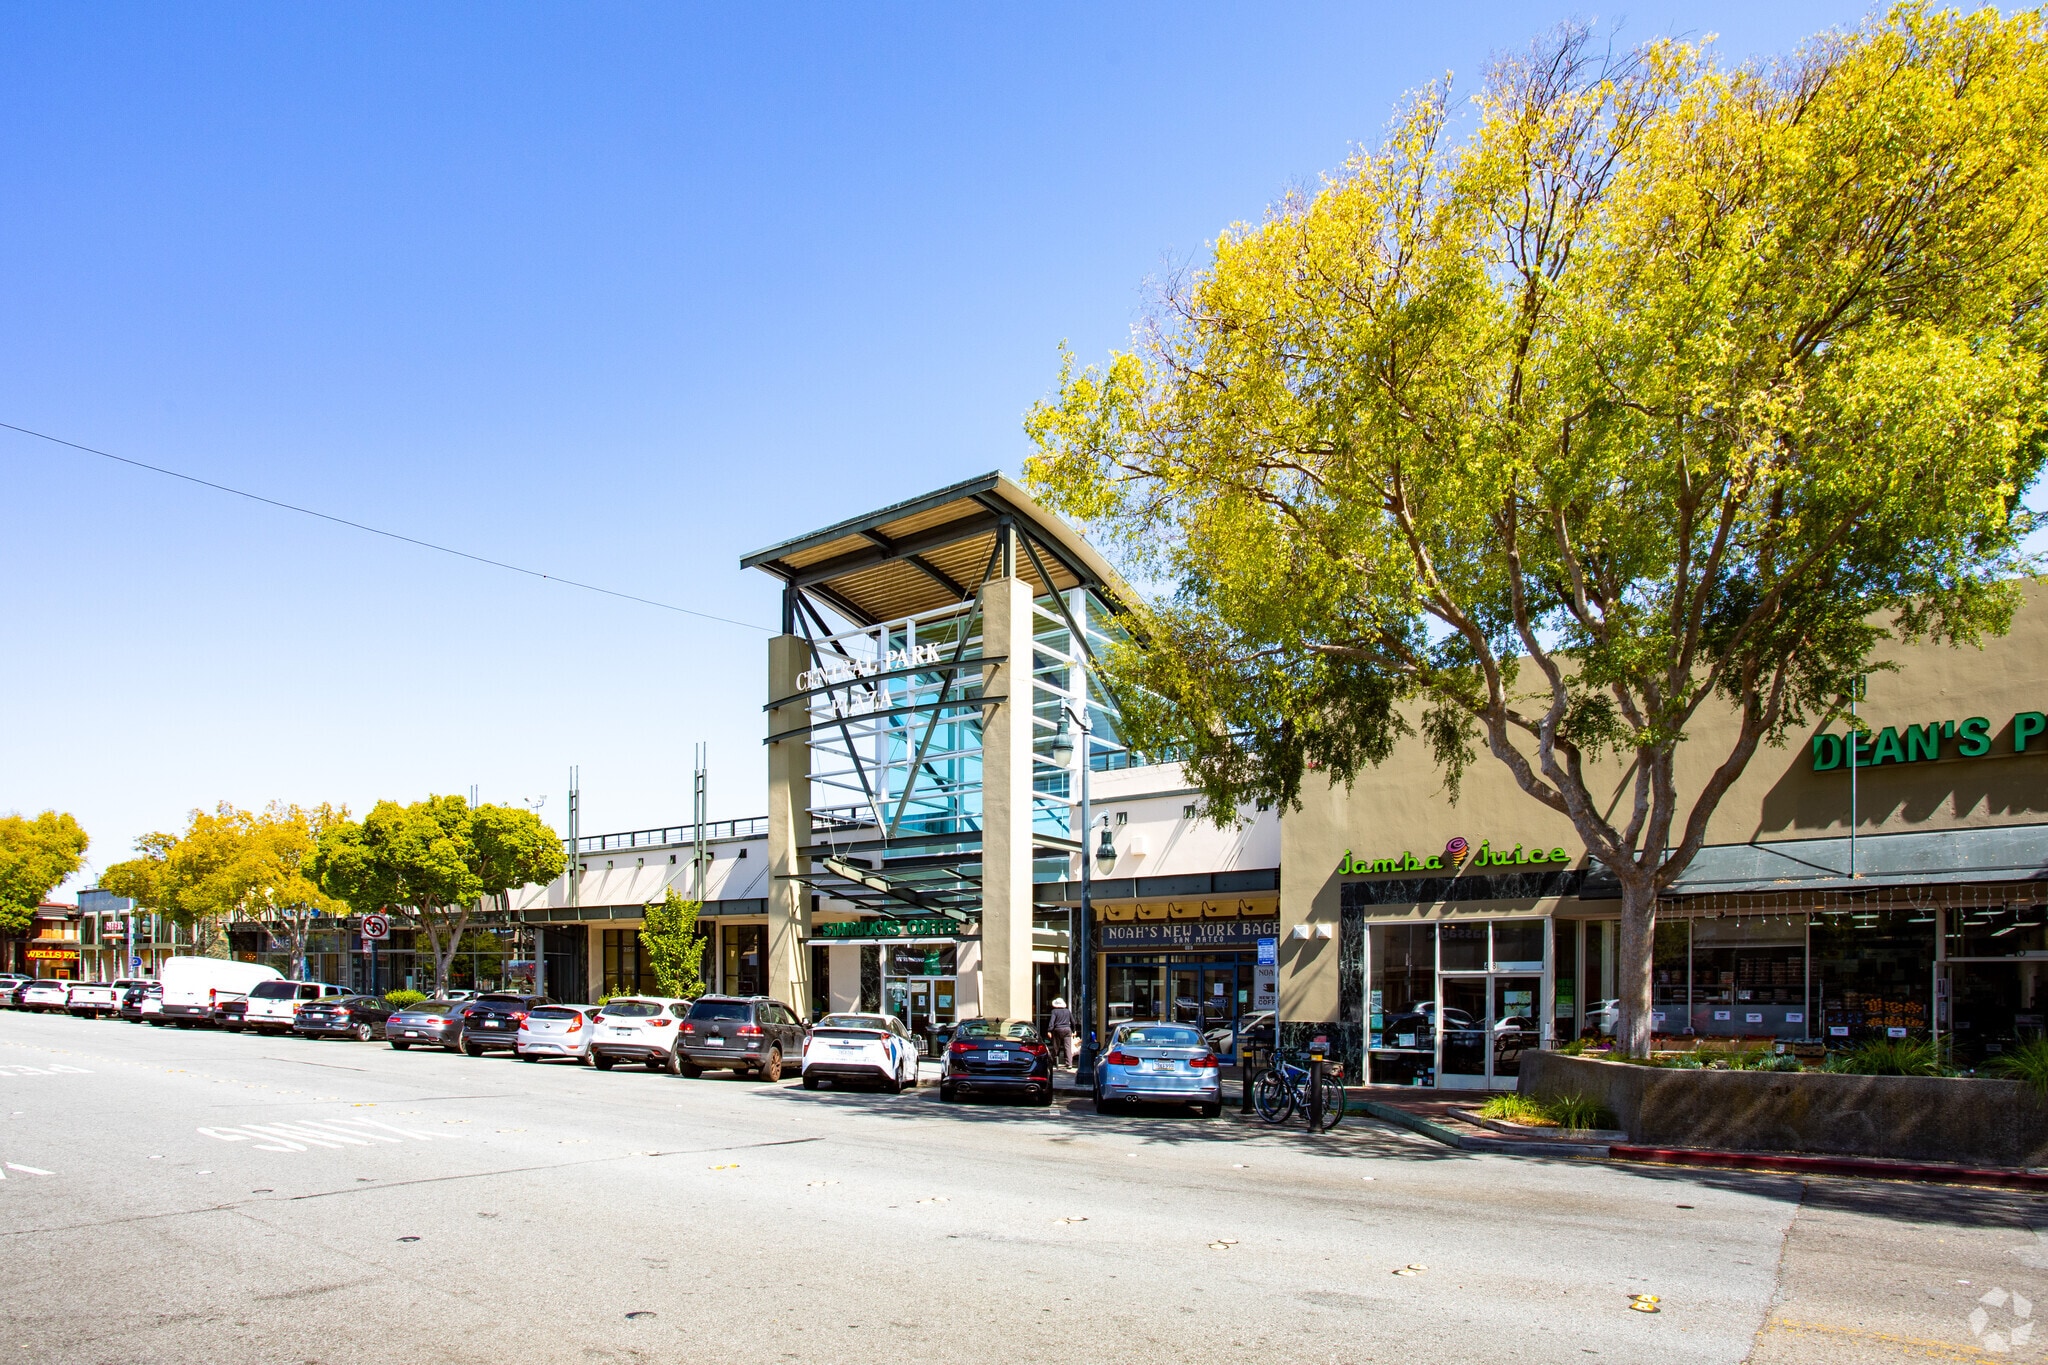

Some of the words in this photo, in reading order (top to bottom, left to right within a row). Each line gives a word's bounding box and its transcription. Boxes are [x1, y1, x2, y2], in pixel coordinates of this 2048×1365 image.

[796, 656, 878, 690] CENTRAL
[885, 642, 941, 670] PARK
[831, 689, 893, 718] PLAZA
[1813, 716, 1992, 771] DEAN'S
[1338, 849, 1444, 875] jamba
[1474, 839, 1571, 867] juice
[822, 920, 900, 937] STARBUCKS
[907, 919, 960, 935] COFFEE
[1109, 926, 1158, 939] NOAH'S
[1163, 925, 1192, 938] NEW
[1198, 923, 1236, 937] YORK
[1195, 935, 1224, 943] MATEO
[27, 950, 62, 959] WELLS
